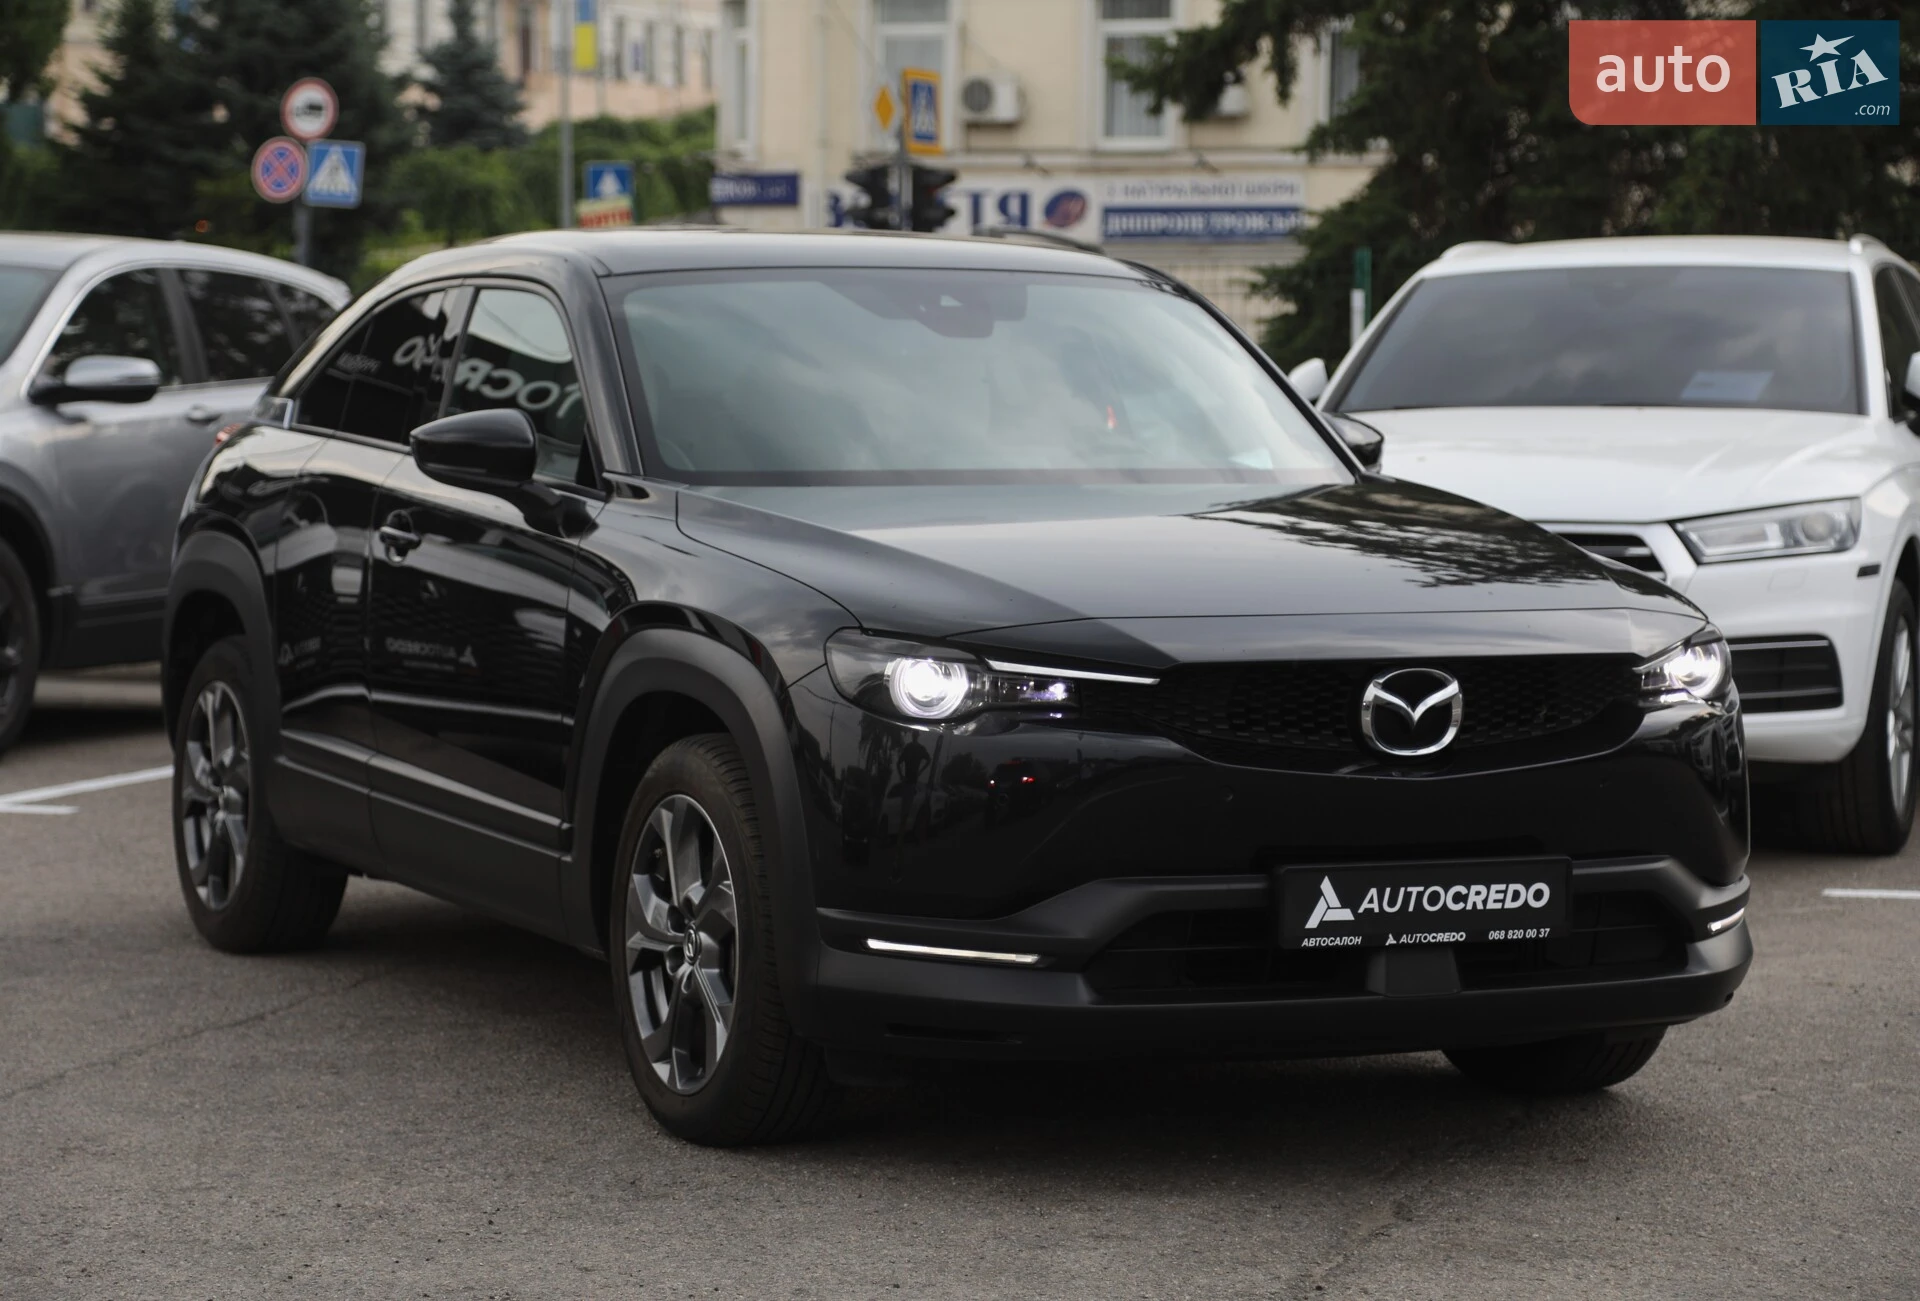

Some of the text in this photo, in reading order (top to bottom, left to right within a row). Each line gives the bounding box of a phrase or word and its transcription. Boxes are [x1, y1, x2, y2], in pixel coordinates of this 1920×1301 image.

[1358, 882, 1551, 914] AUTOCREDO
[1399, 931, 1467, 944] AUTOCREDO
[1488, 927, 1551, 940] 068 820 00 37
[1301, 935, 1363, 948] АВТОСАЛОН
